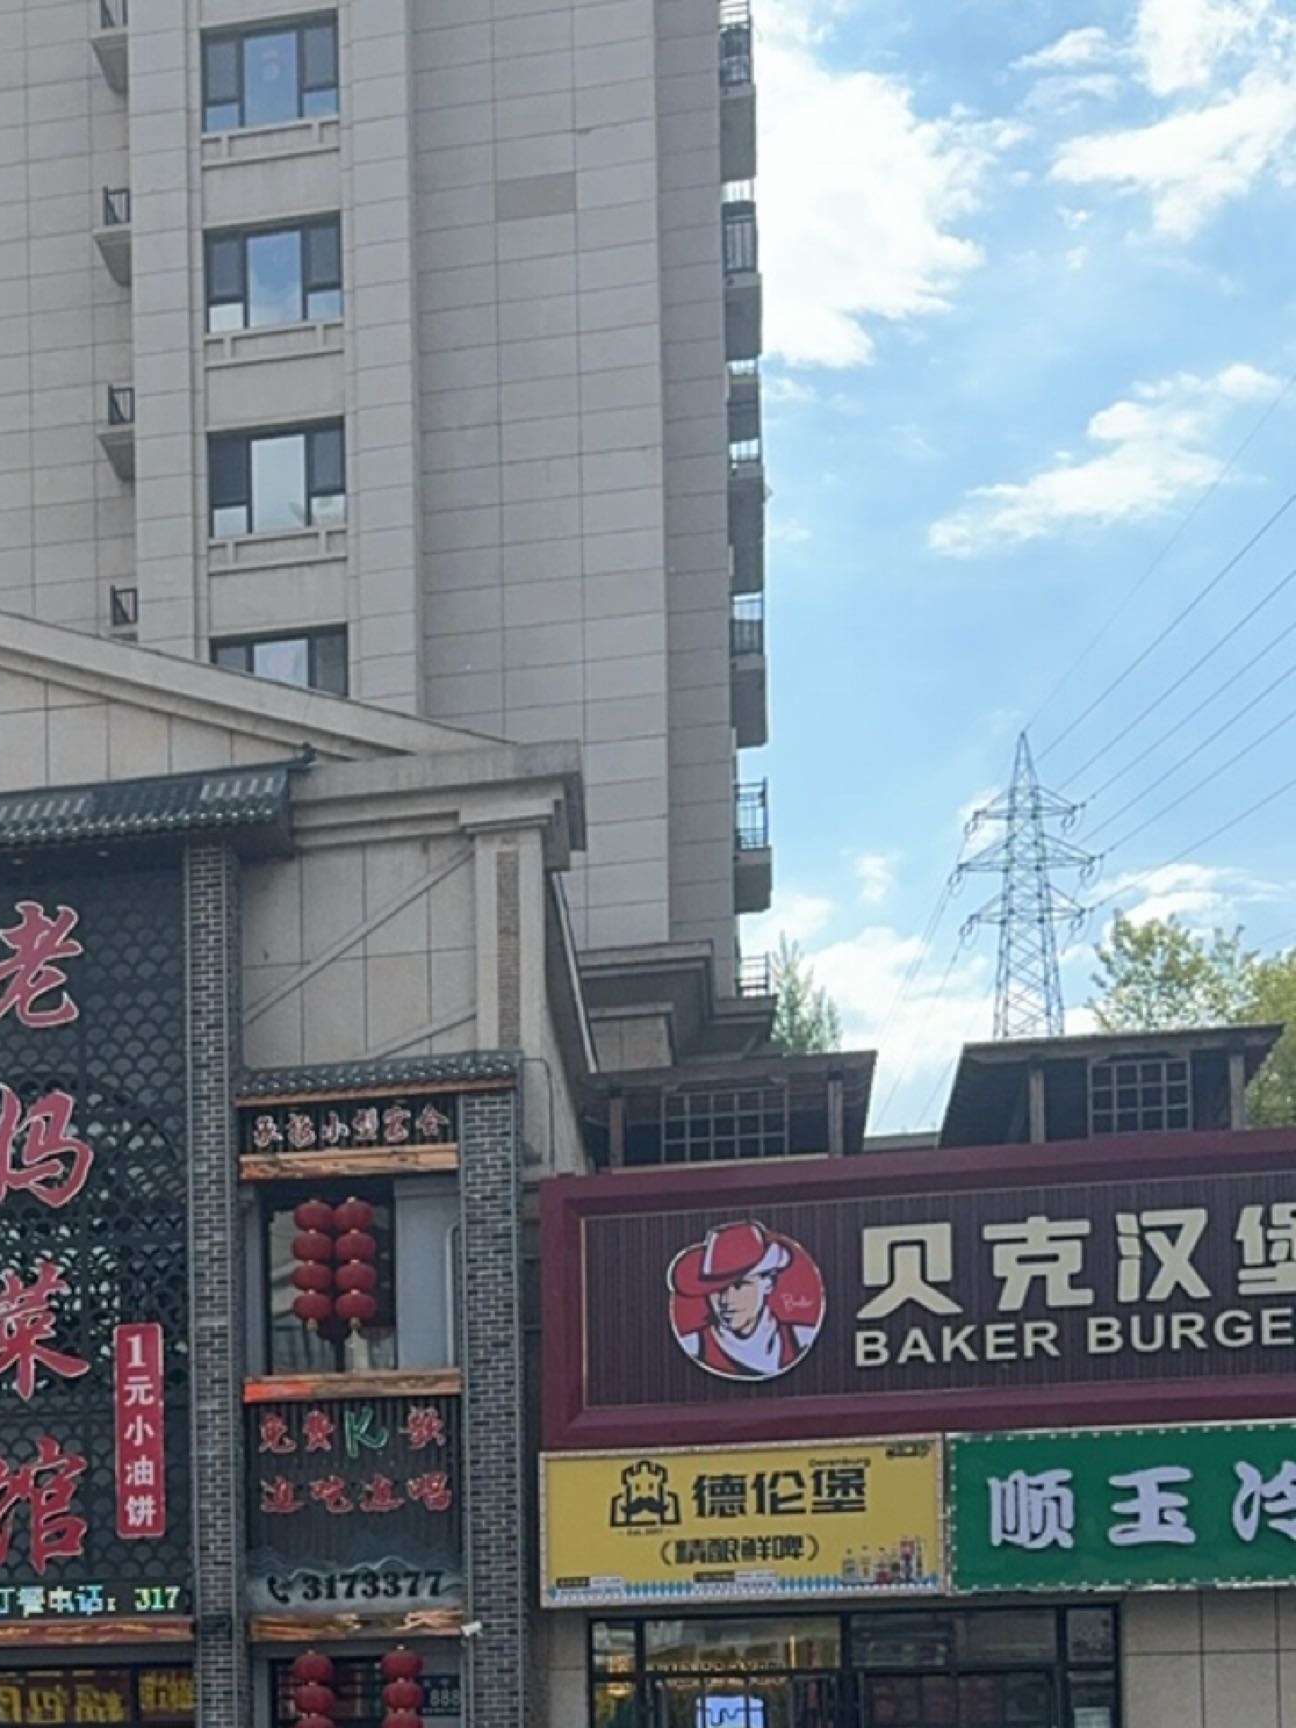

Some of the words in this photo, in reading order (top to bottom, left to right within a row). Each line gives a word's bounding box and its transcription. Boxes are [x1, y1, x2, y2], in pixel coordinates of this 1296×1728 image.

[856, 1202, 1296, 1319] 贝克汉堡
[854, 1320, 1062, 1369] BAKER
[1086, 1308, 1296, 1356] BURGE
[122, 1333, 156, 1529] 1元小油饼
[258, 1405, 446, 1458] 免费K歌
[691, 1466, 867, 1519] 德伦堡
[302, 1571, 444, 1602] 3173377
